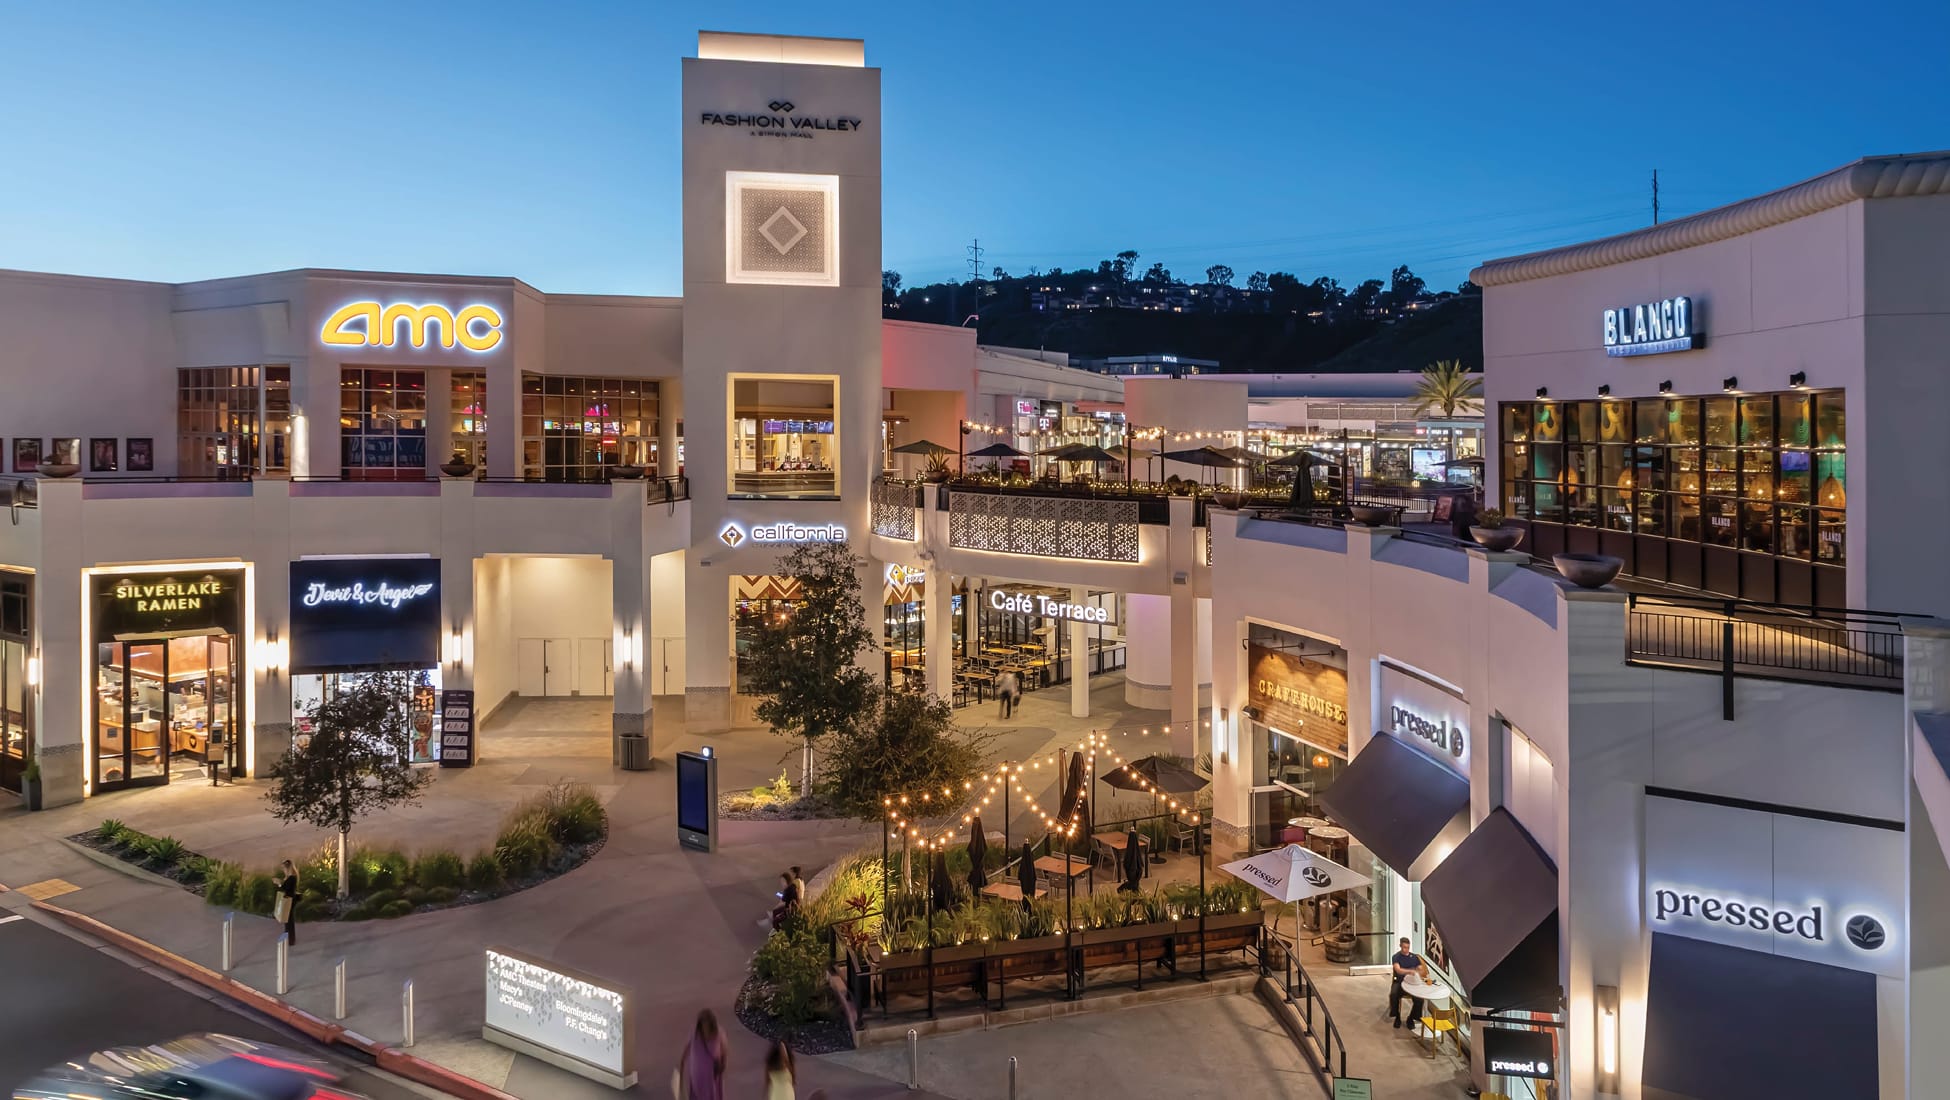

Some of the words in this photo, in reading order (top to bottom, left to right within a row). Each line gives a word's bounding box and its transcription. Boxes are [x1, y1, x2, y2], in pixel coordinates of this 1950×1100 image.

[702, 113, 785, 128] FASHION
[790, 117, 861, 131] VALLEY
[1603, 296, 1687, 345] BLANCO
[1711, 516, 1731, 528] BLANCO
[116, 583, 221, 599] SILVERLAKE
[303, 582, 352, 606] Devil
[352, 582, 364, 604] &
[364, 582, 416, 609] Angel
[137, 598, 201, 612] RAMEN
[991, 590, 1033, 613] Café
[1036, 595, 1108, 622] Terrace
[1259, 679, 1343, 721] CRAFTHOUSE
[1391, 705, 1446, 749] pressed
[1242, 863, 1283, 887] pressed
[1655, 889, 1824, 941] pressed
[500, 968, 518, 982] AMC
[500, 981, 522, 997] Macy's
[1491, 1060, 1534, 1072] pressed
